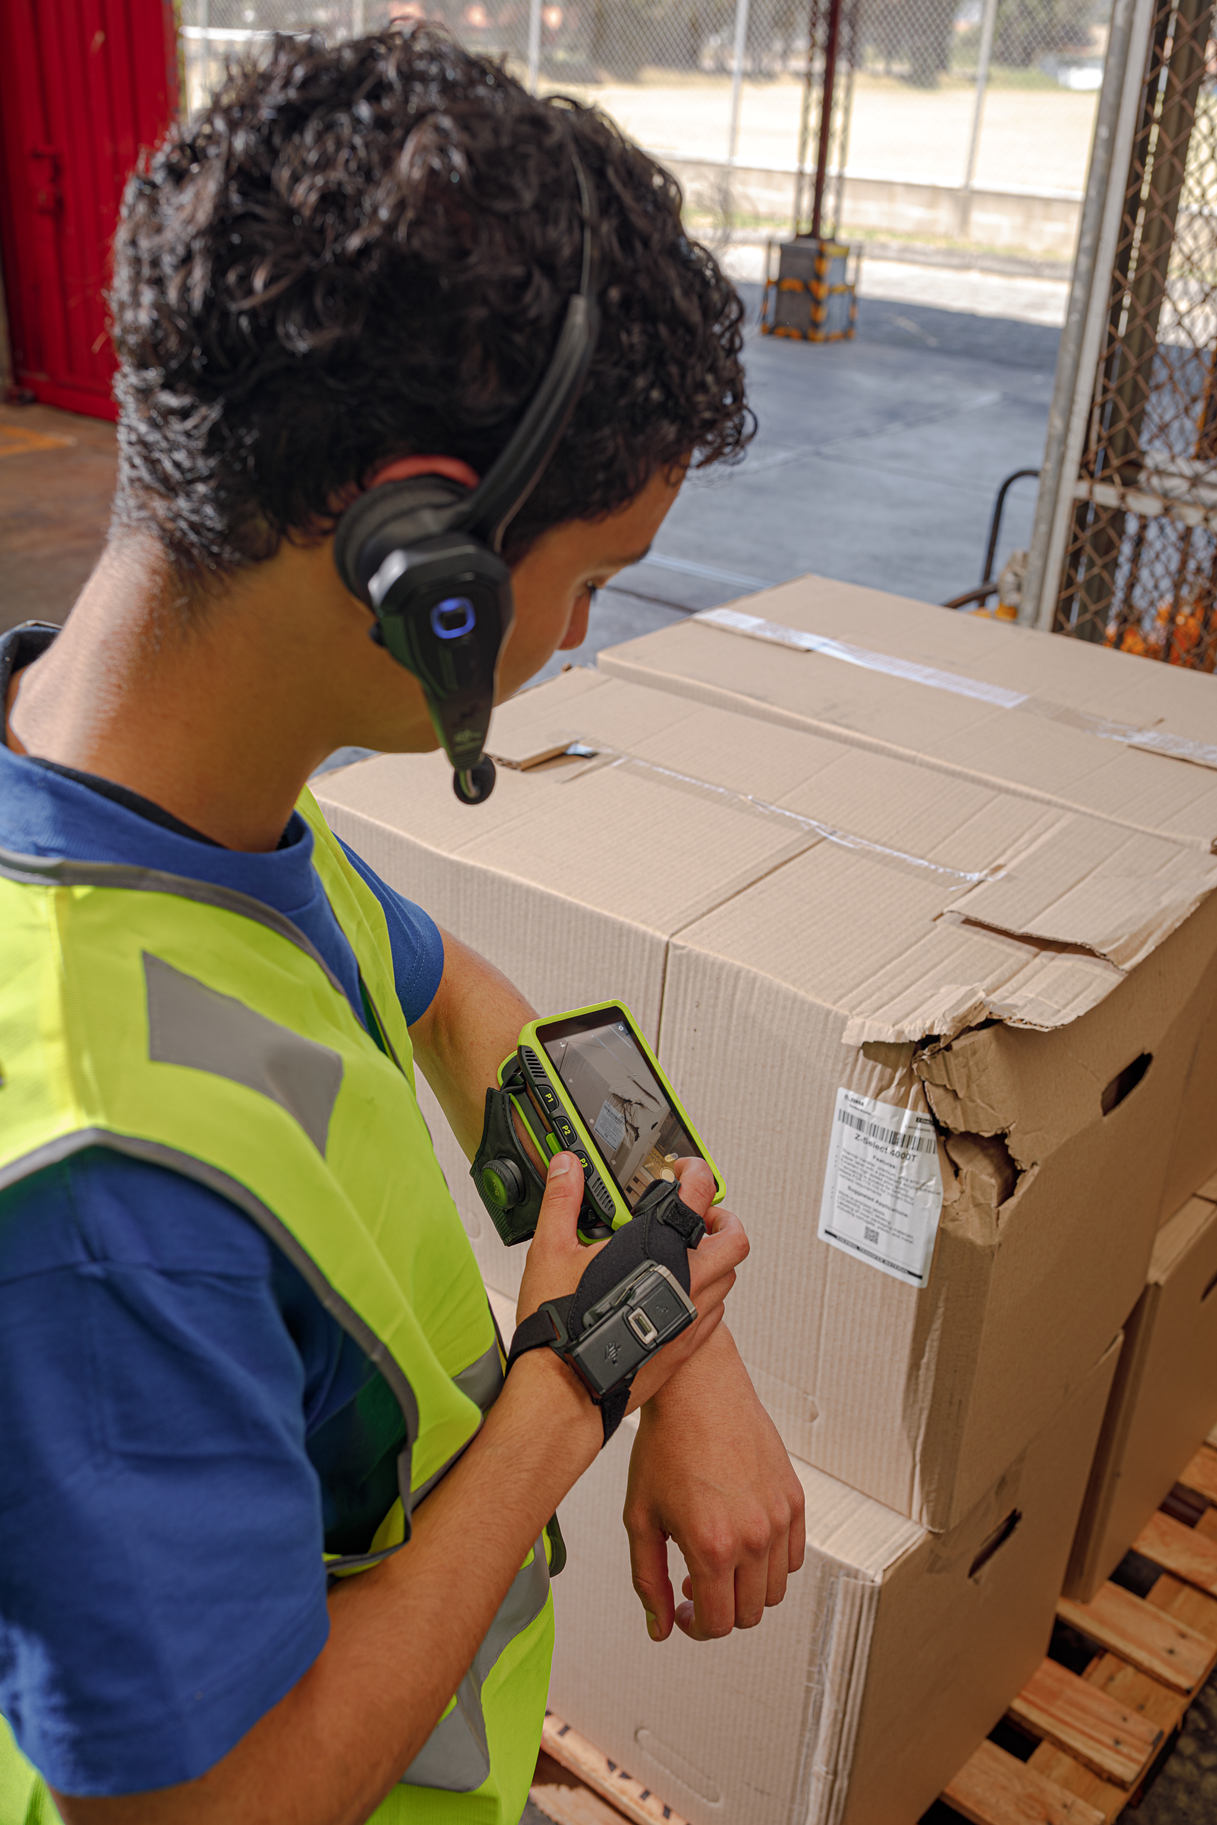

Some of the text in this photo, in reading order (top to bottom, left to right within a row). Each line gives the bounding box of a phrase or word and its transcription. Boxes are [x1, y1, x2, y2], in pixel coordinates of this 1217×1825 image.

[545, 1093, 554, 1103] P1
[562, 1125, 571, 1135] P2
[854, 1132, 917, 1162] Z-Select 4000T
[580, 1158, 589, 1168] P3
